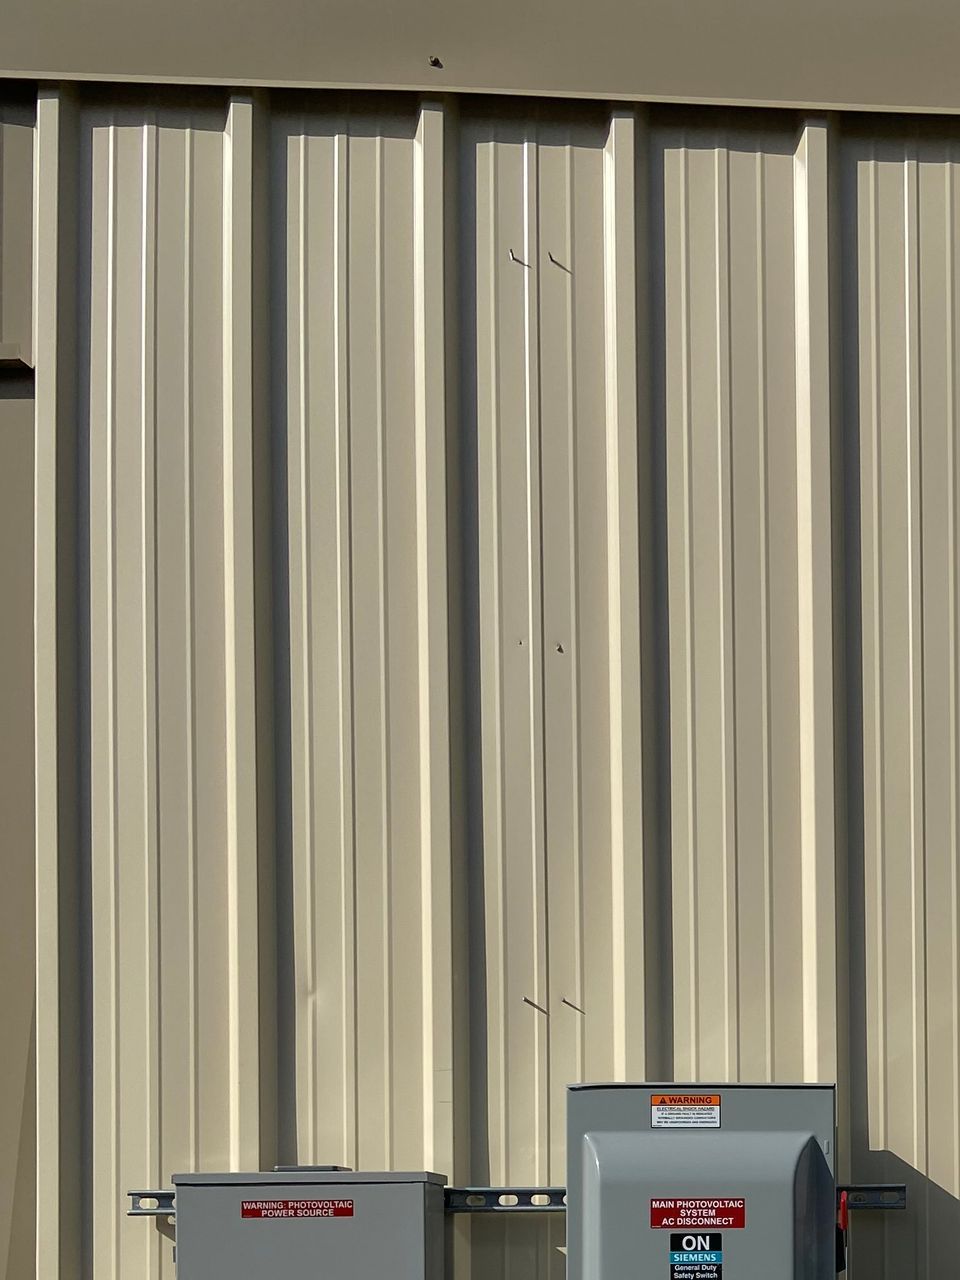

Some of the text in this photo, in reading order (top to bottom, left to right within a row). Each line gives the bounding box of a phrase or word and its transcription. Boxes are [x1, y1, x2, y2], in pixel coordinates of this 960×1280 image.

[242, 1201, 353, 1210] WARNING: PHOTOVOLTAIC
[652, 1200, 674, 1208] MAIN
[262, 1209, 334, 1217] POWER SOURCE
[682, 1236, 710, 1250] ON
[674, 1254, 716, 1262] SIEMENS
